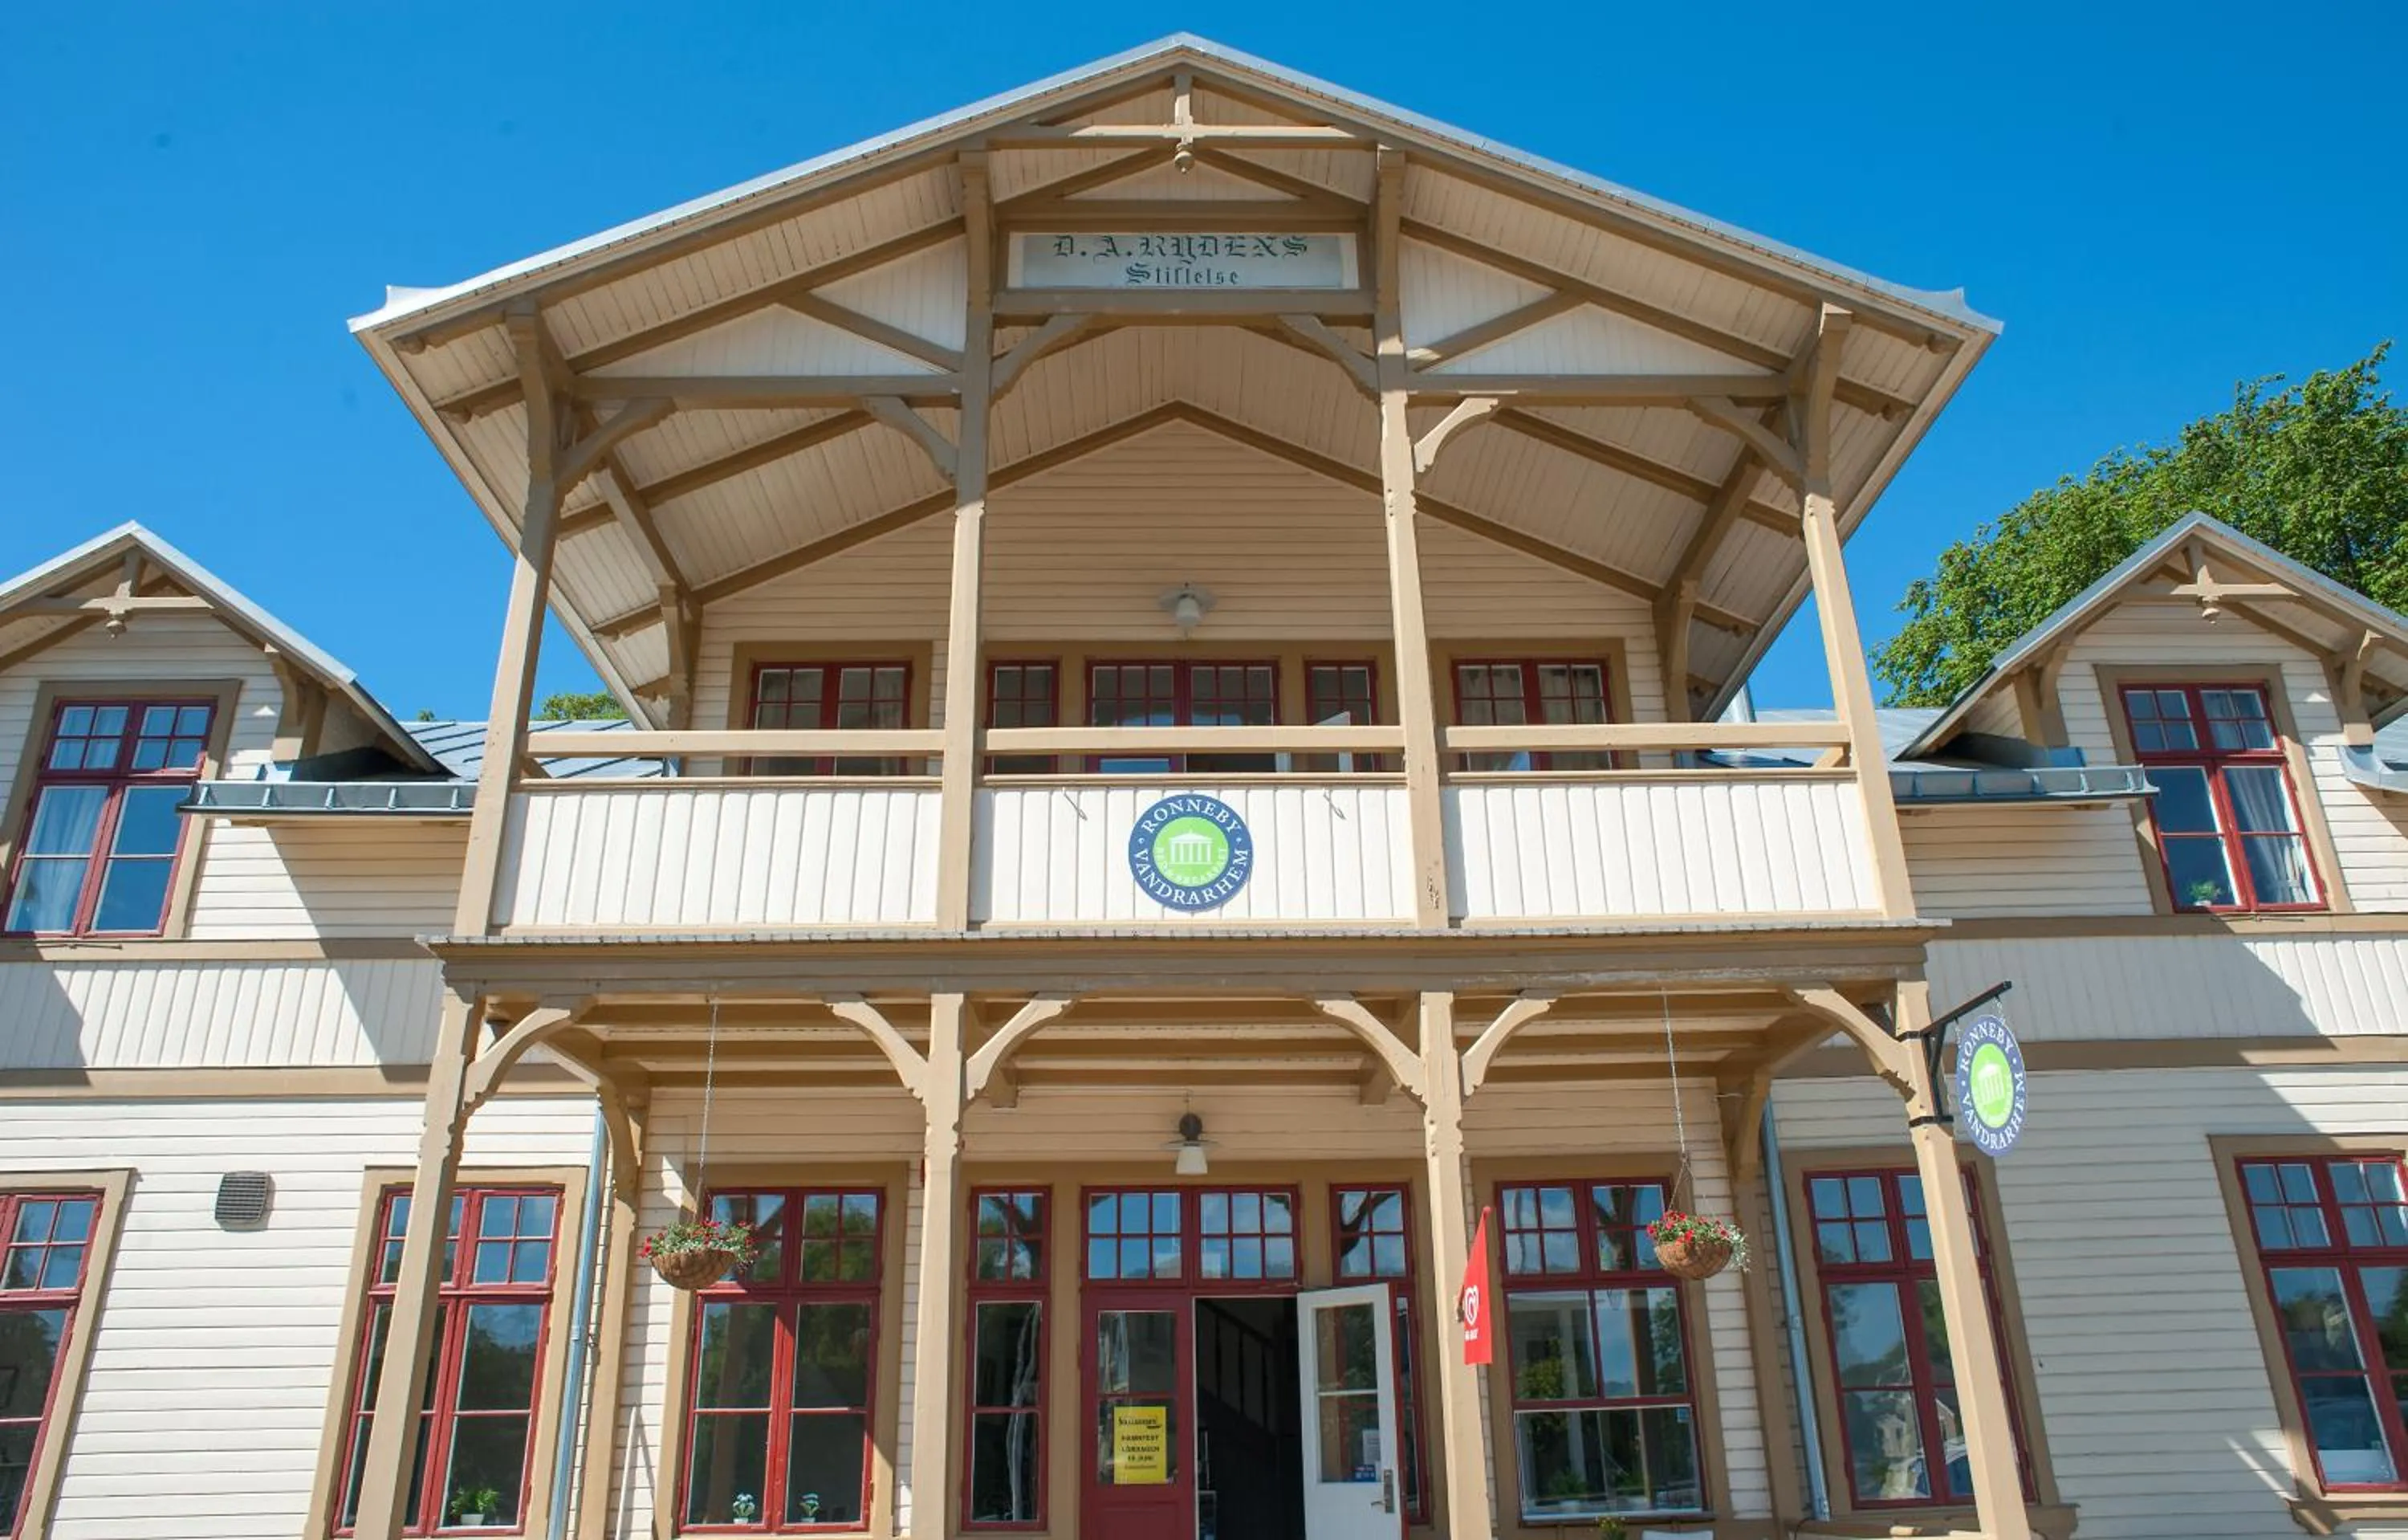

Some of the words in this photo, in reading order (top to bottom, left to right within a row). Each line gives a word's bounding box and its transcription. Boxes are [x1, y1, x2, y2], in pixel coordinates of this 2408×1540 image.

[1141, 799, 1242, 834] RONNEBY
[1134, 848, 1249, 905] VANDRARHEM
[1959, 1021, 2015, 1073] RONNEBY
[1962, 1072, 2025, 1150] VANDRARHEM
